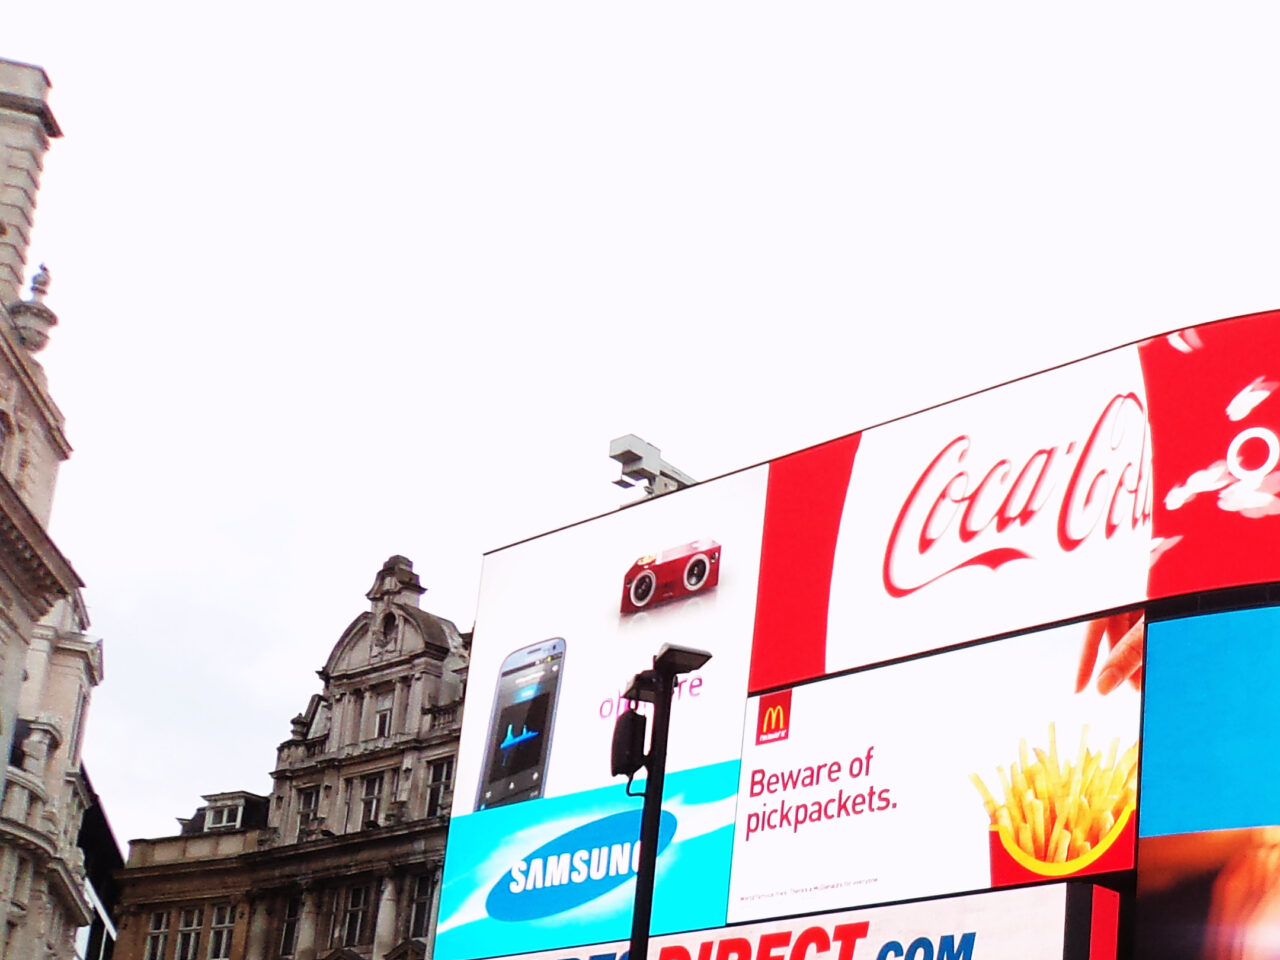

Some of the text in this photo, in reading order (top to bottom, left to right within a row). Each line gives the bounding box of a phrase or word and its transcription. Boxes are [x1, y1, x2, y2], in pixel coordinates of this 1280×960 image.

[749, 746, 874, 798] Beware of
[745, 785, 897, 842] pickpackets.
